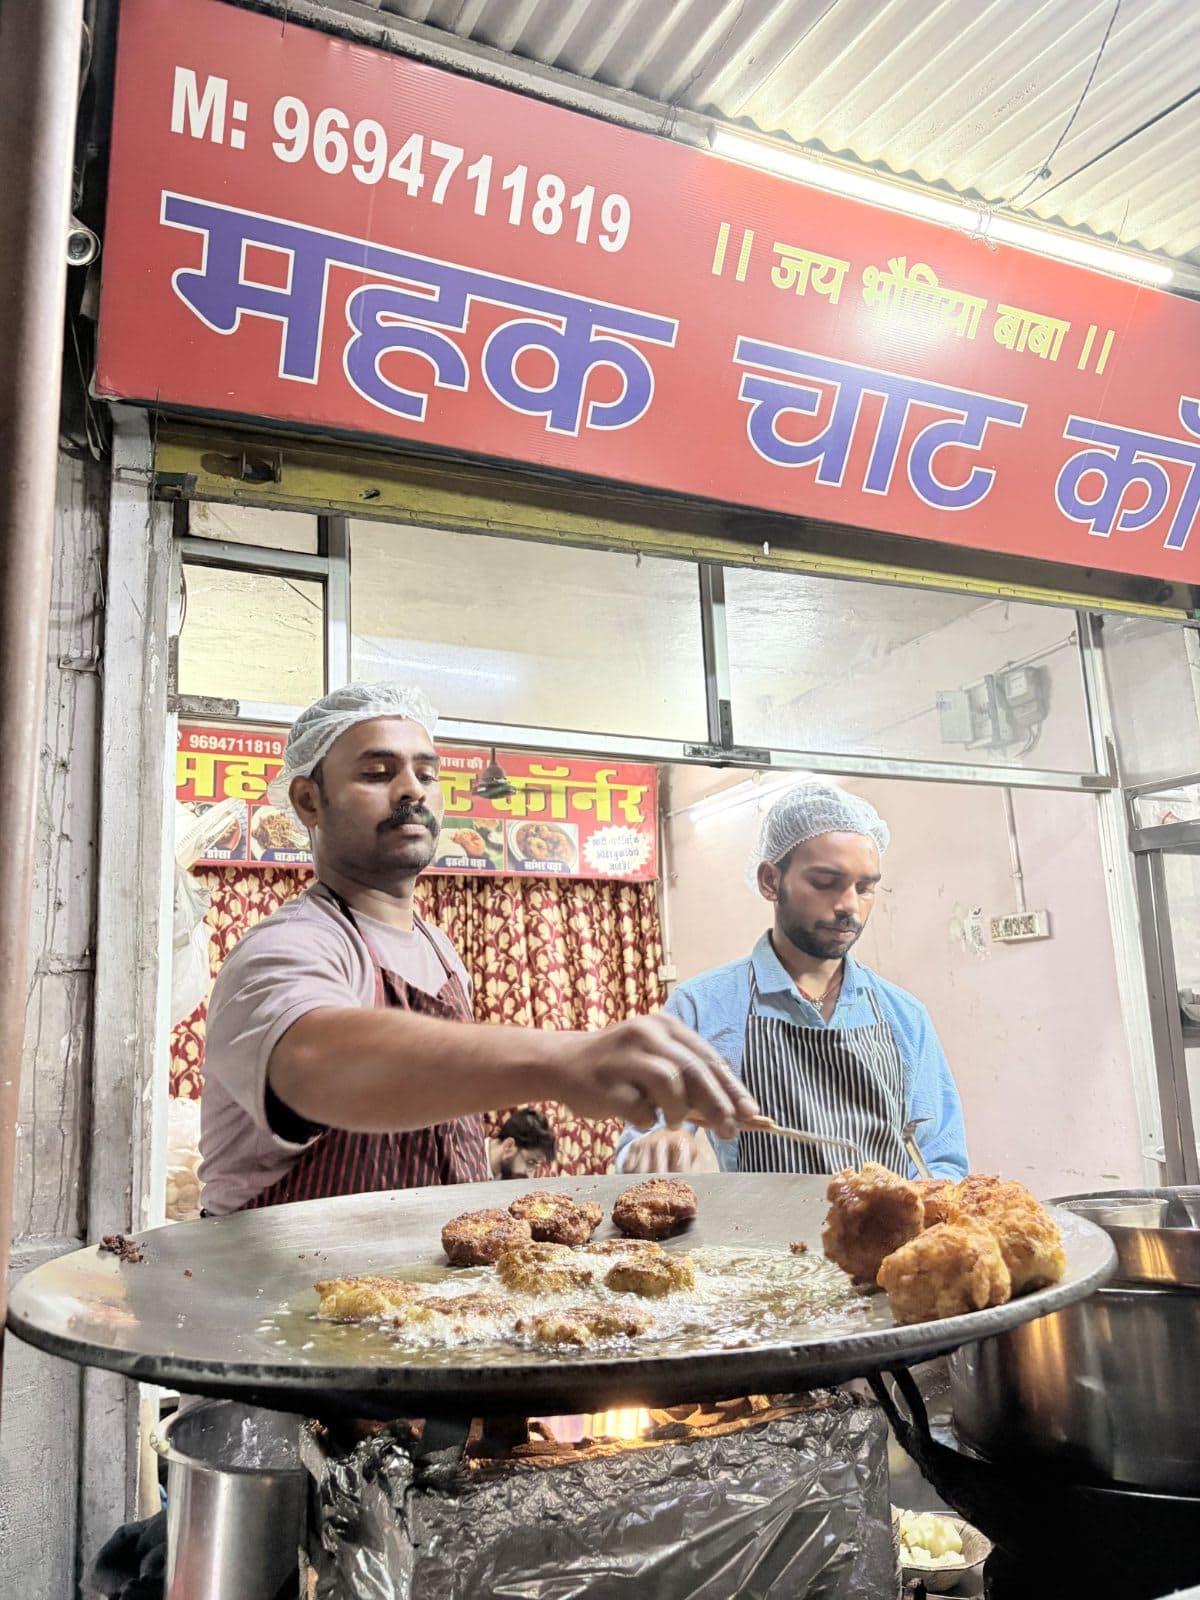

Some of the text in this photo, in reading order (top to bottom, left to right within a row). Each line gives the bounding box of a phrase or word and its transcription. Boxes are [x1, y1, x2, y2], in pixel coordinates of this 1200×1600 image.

[170, 66, 631, 253] M: 9694711819
[160, 189, 679, 437] महक
[733, 335, 1028, 510] चाट
[771, 241, 850, 304] जय
[993, 303, 1070, 362] बाबा
[190, 734, 282, 755] 9694711819
[491, 764, 648, 824] कॉर्नर
